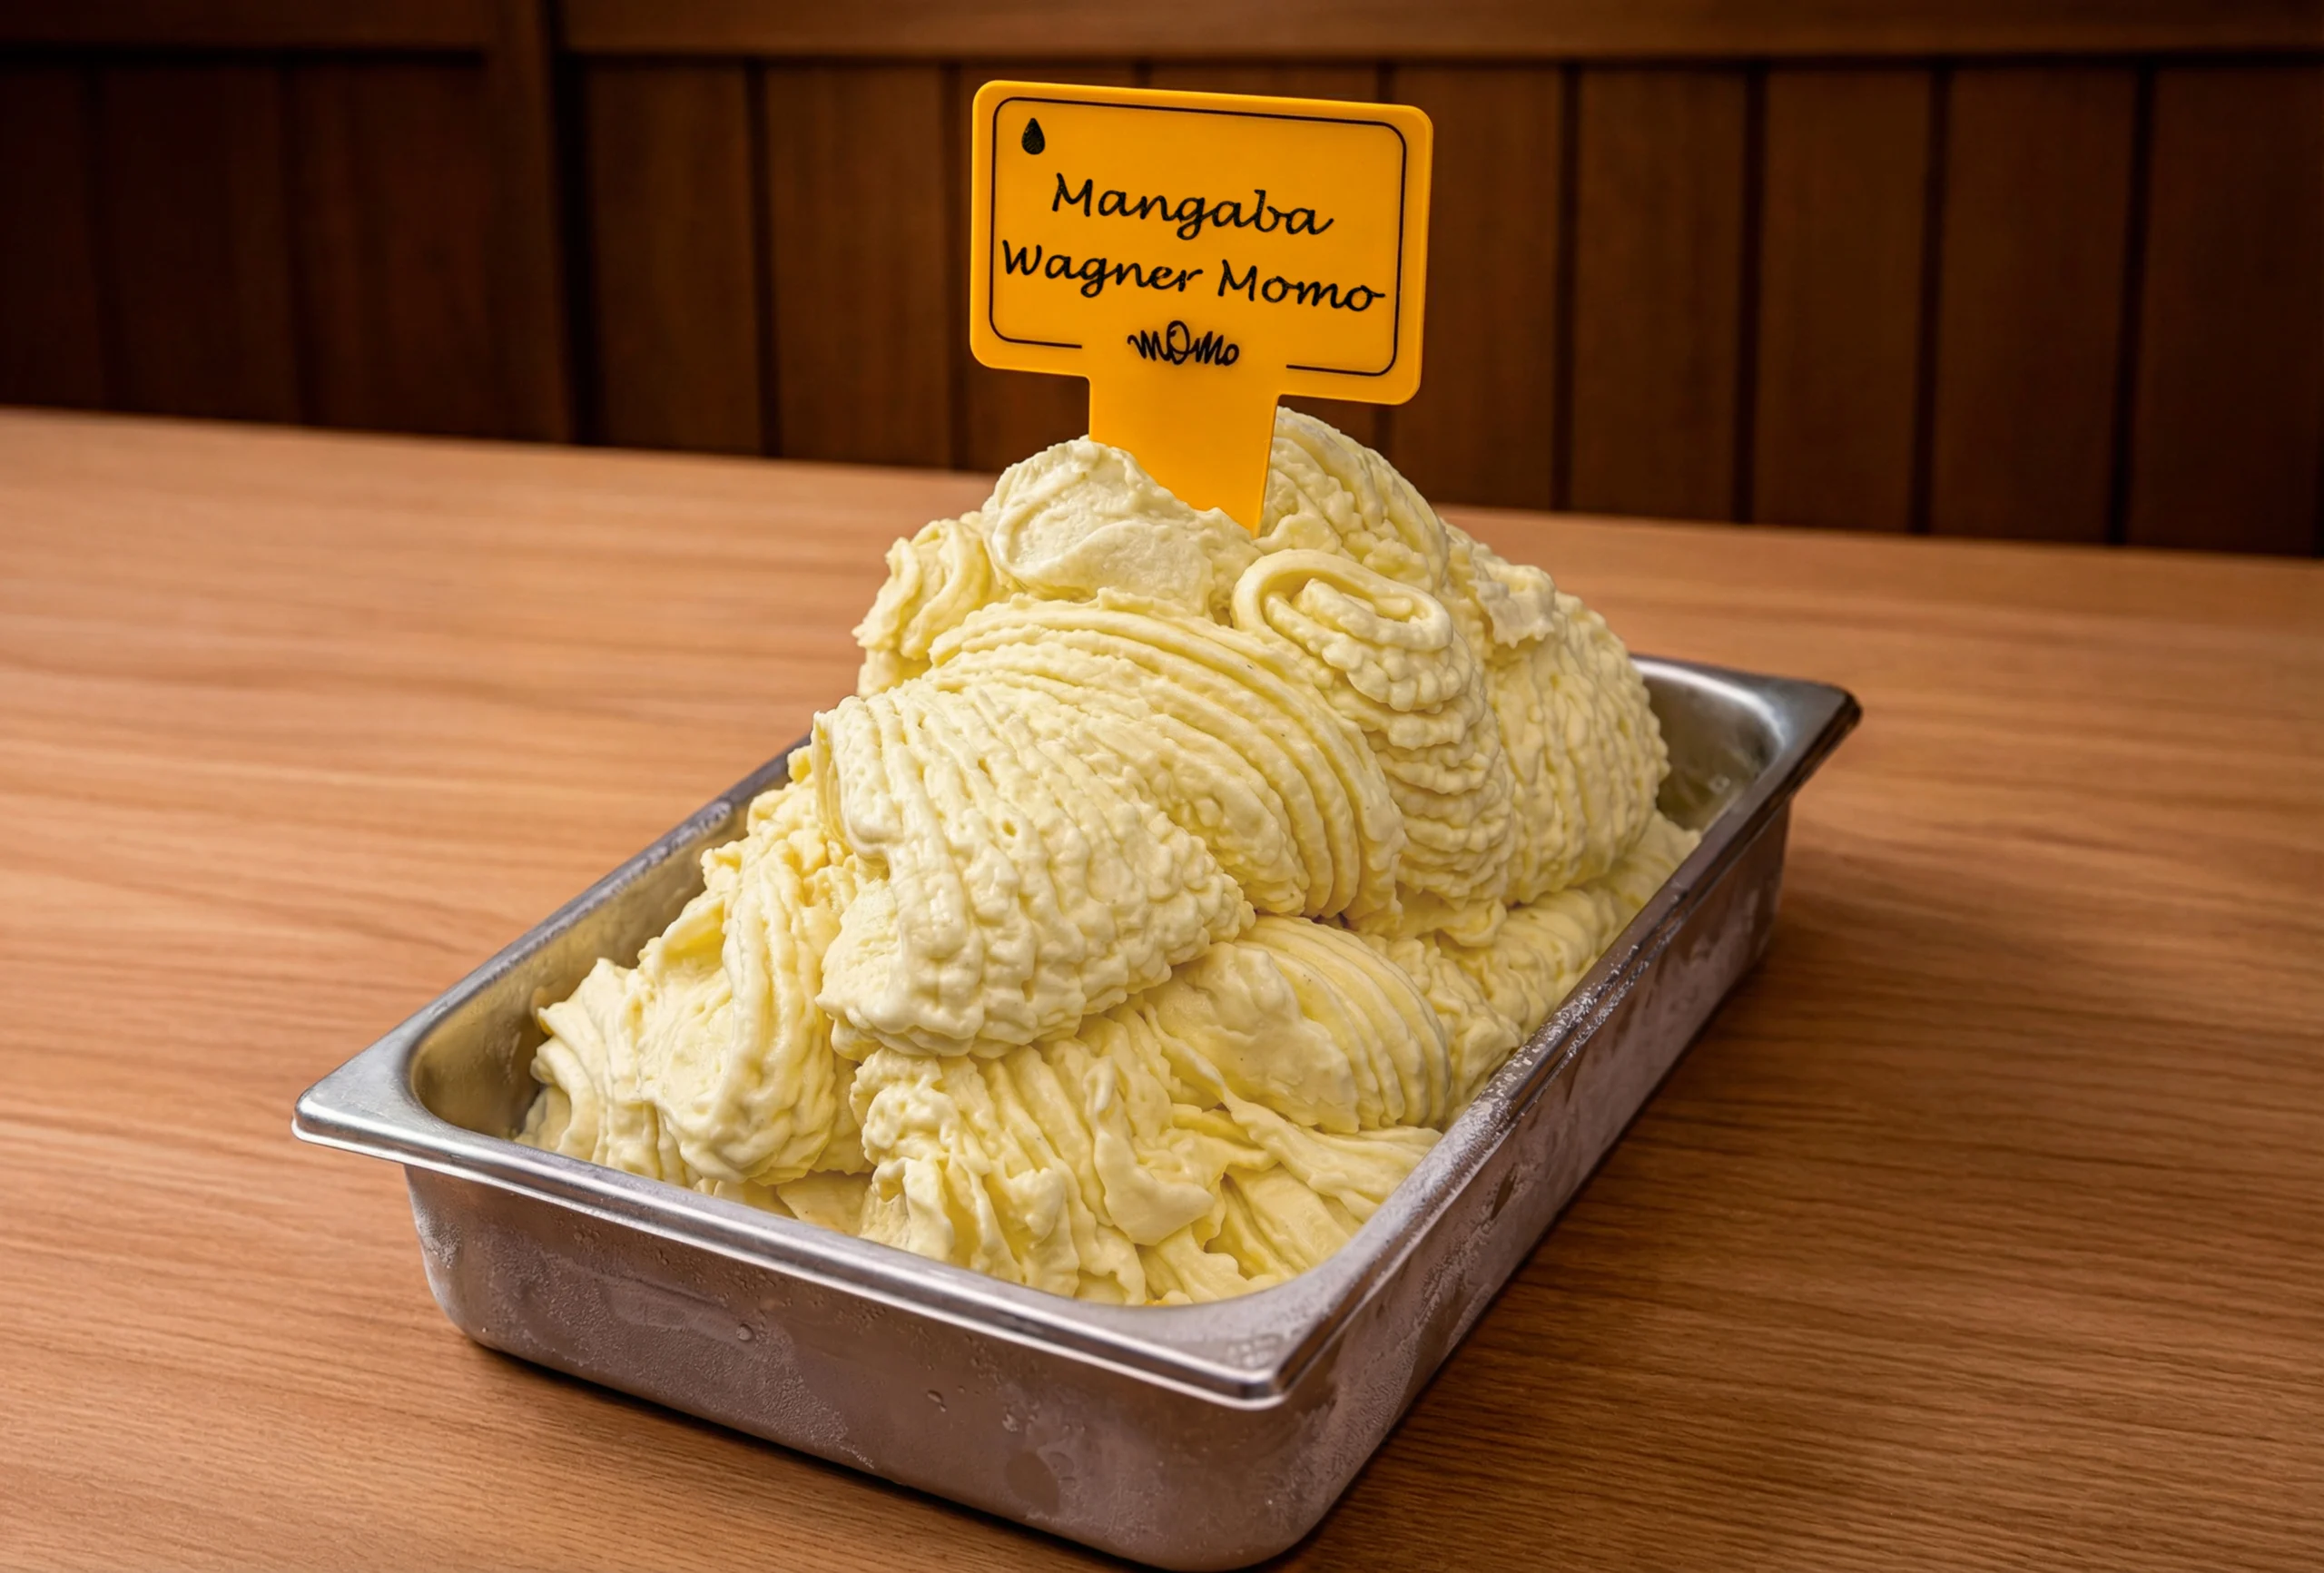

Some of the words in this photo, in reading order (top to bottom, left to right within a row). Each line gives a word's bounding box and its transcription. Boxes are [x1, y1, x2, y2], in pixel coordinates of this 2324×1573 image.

[1050, 172, 1335, 241] Mangaba
[1001, 239, 1205, 300] Wagner
[1216, 258, 1387, 313] Momo
